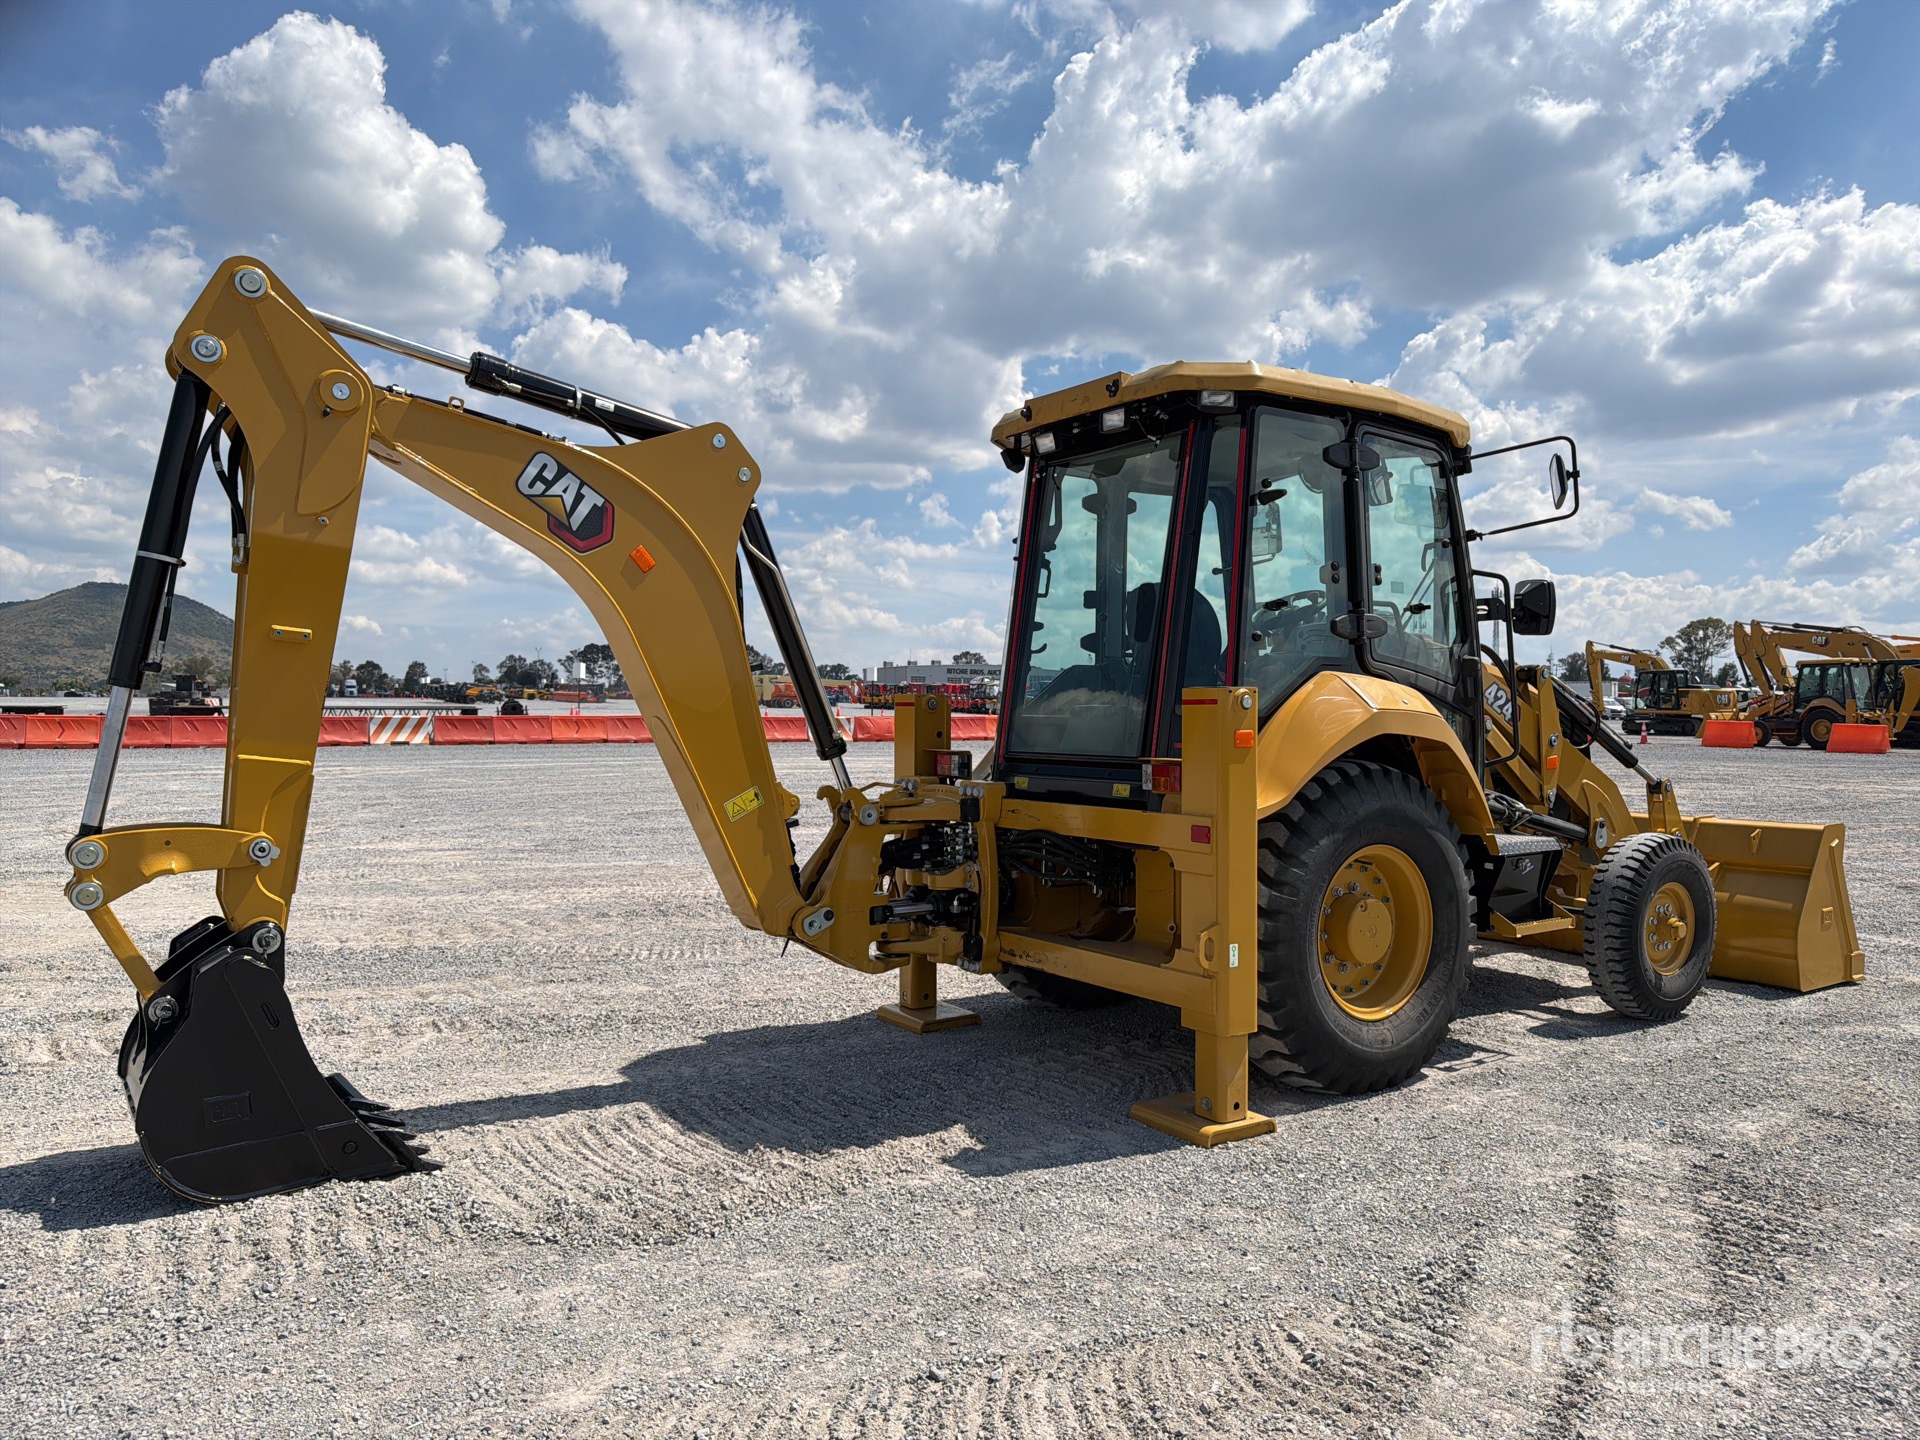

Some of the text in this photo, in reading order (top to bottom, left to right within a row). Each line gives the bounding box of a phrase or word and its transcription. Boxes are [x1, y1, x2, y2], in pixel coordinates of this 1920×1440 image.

[517, 452, 606, 532] CAT
[1811, 635, 1827, 645] CAT
[970, 668, 986, 676] BROS.
[1484, 683, 1513, 722] 424
[1716, 693, 1728, 705] CAT
